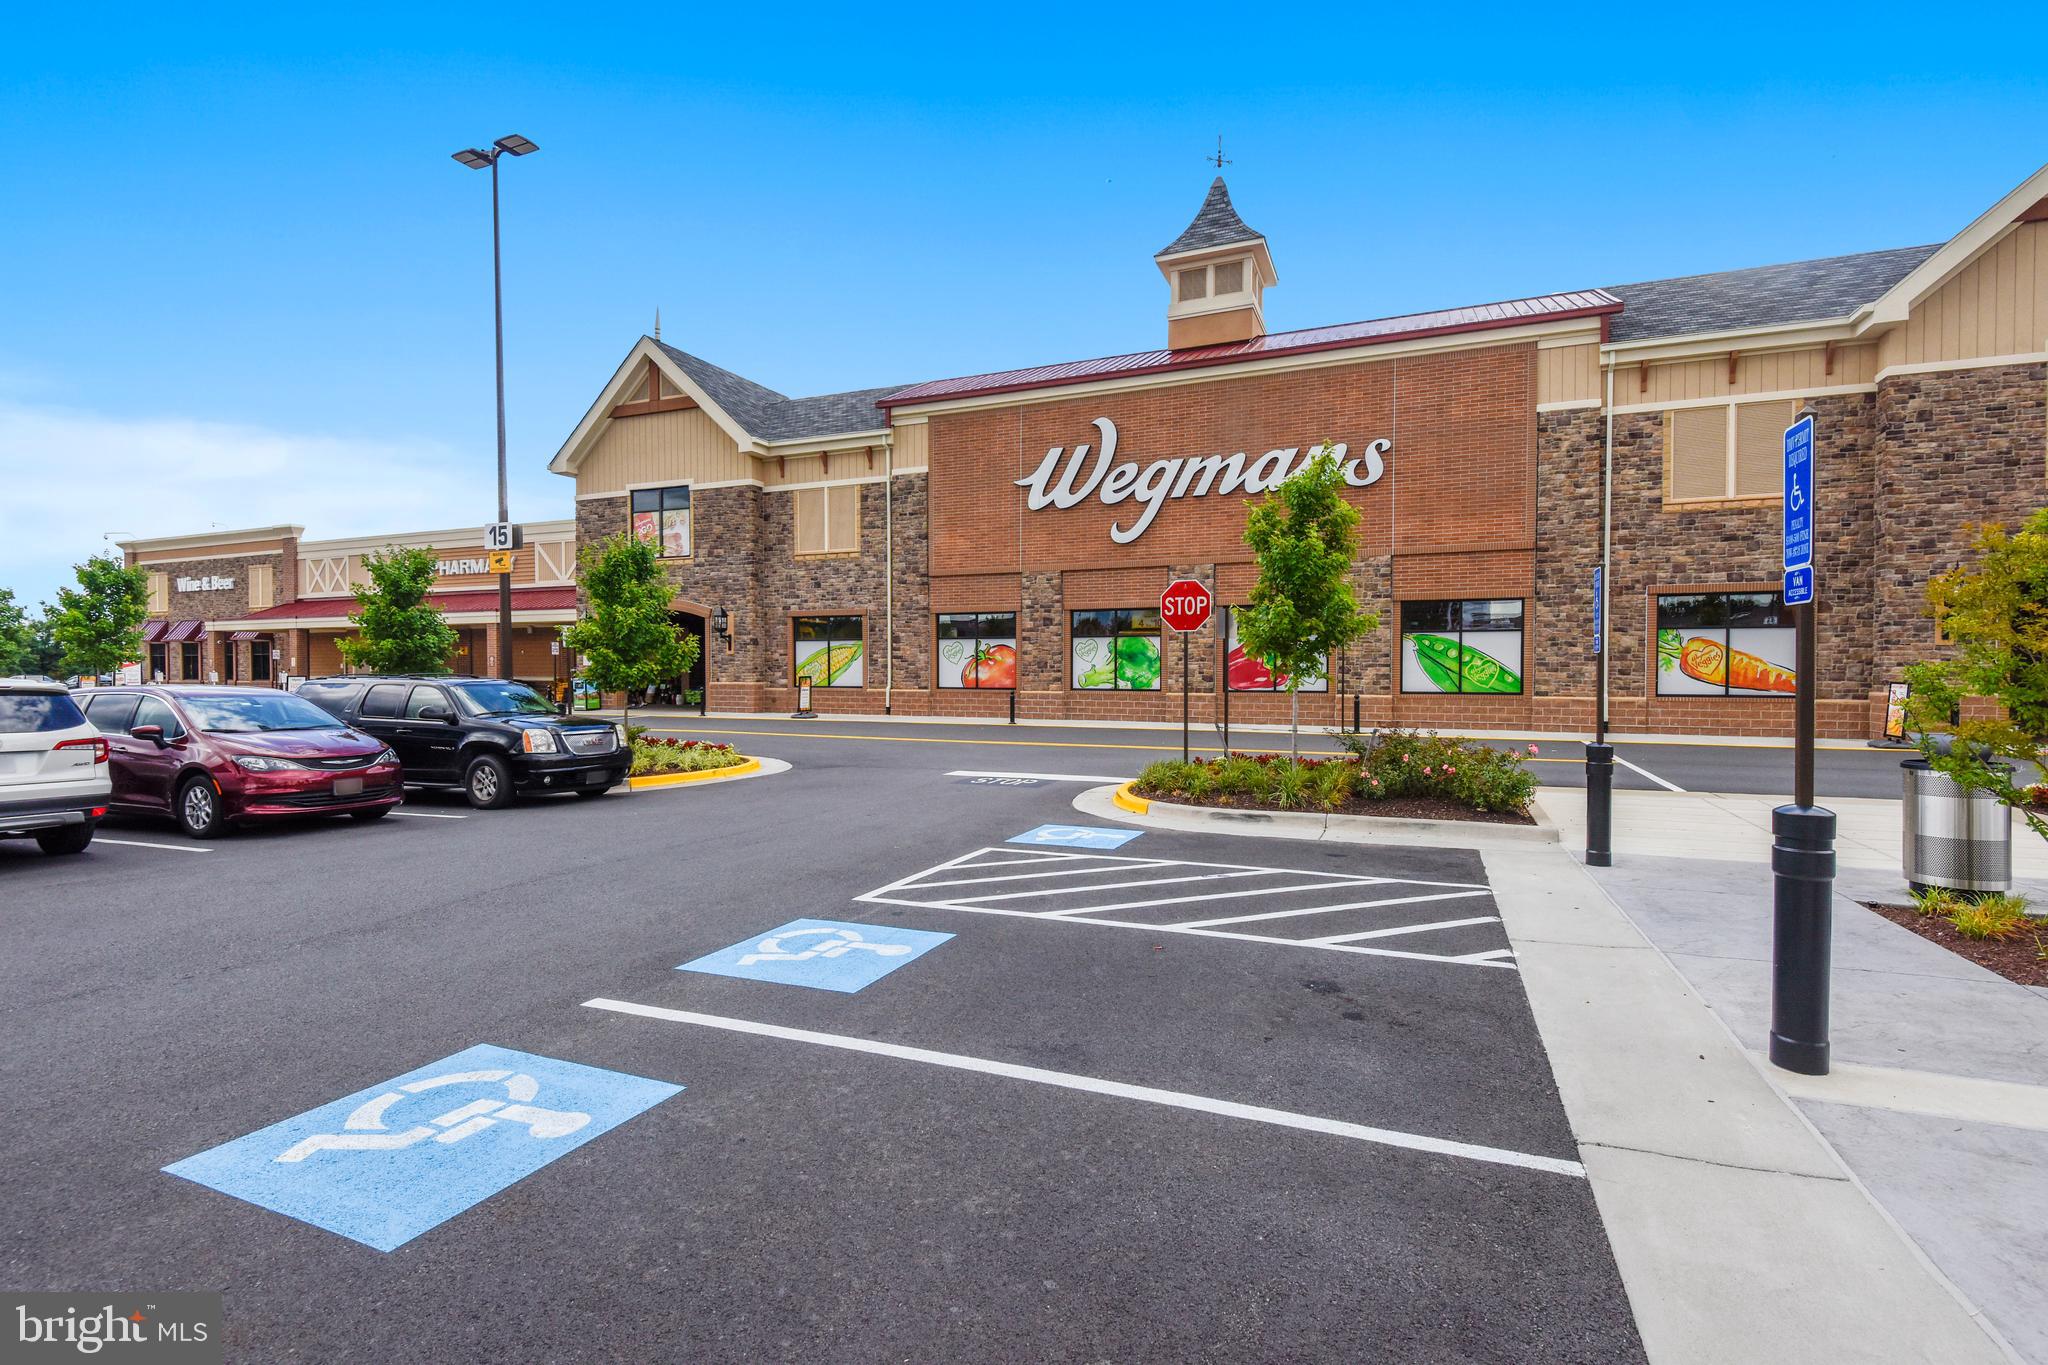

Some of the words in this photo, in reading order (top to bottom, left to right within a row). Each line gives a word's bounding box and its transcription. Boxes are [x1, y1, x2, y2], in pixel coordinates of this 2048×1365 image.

[1014, 417, 1392, 544] Wegmans
[488, 525, 508, 546] 15
[434, 555, 515, 575] HARM
[176, 576, 202, 592] Wine
[211, 575, 236, 590] Beer
[1792, 576, 1804, 586] VAN
[1164, 596, 1208, 615] STOP
[970, 777, 1039, 786] STOP
